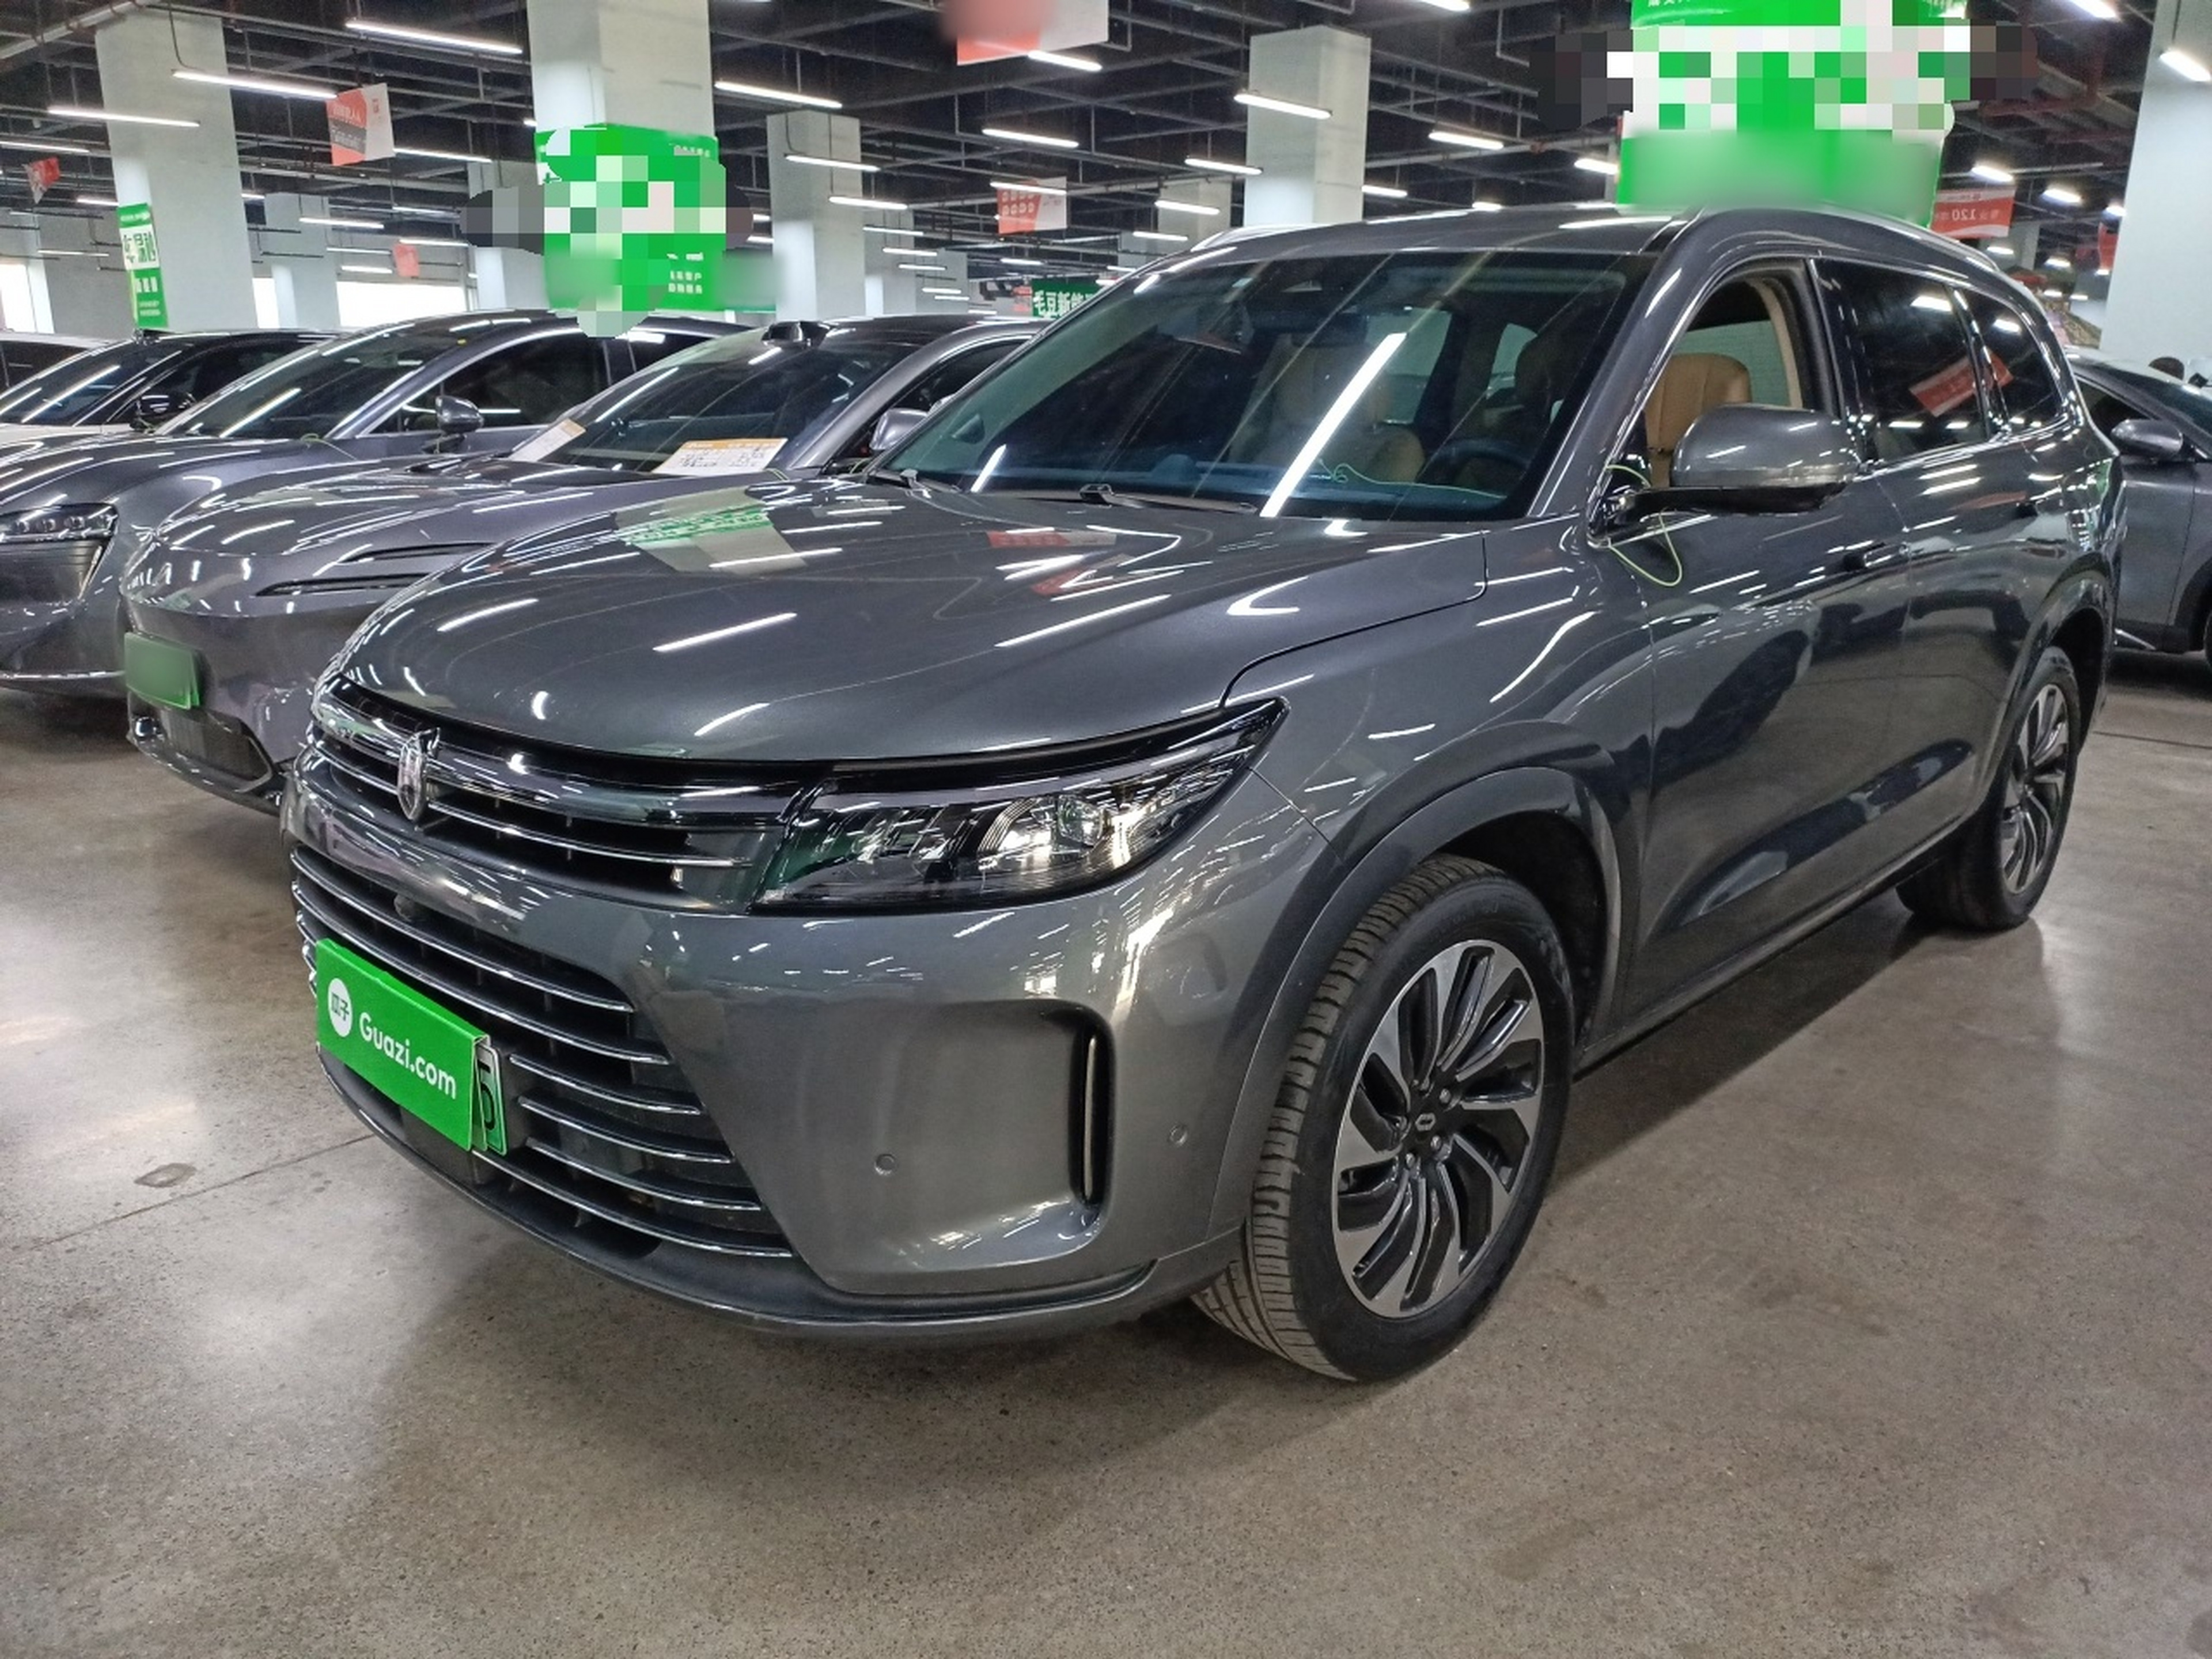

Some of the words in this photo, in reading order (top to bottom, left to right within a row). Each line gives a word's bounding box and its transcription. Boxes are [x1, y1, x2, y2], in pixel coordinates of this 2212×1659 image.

[1033, 290, 1094, 317] 毛豆新能
[332, 993, 349, 1021] 瓜子
[359, 1013, 456, 1099] Guazi.com
